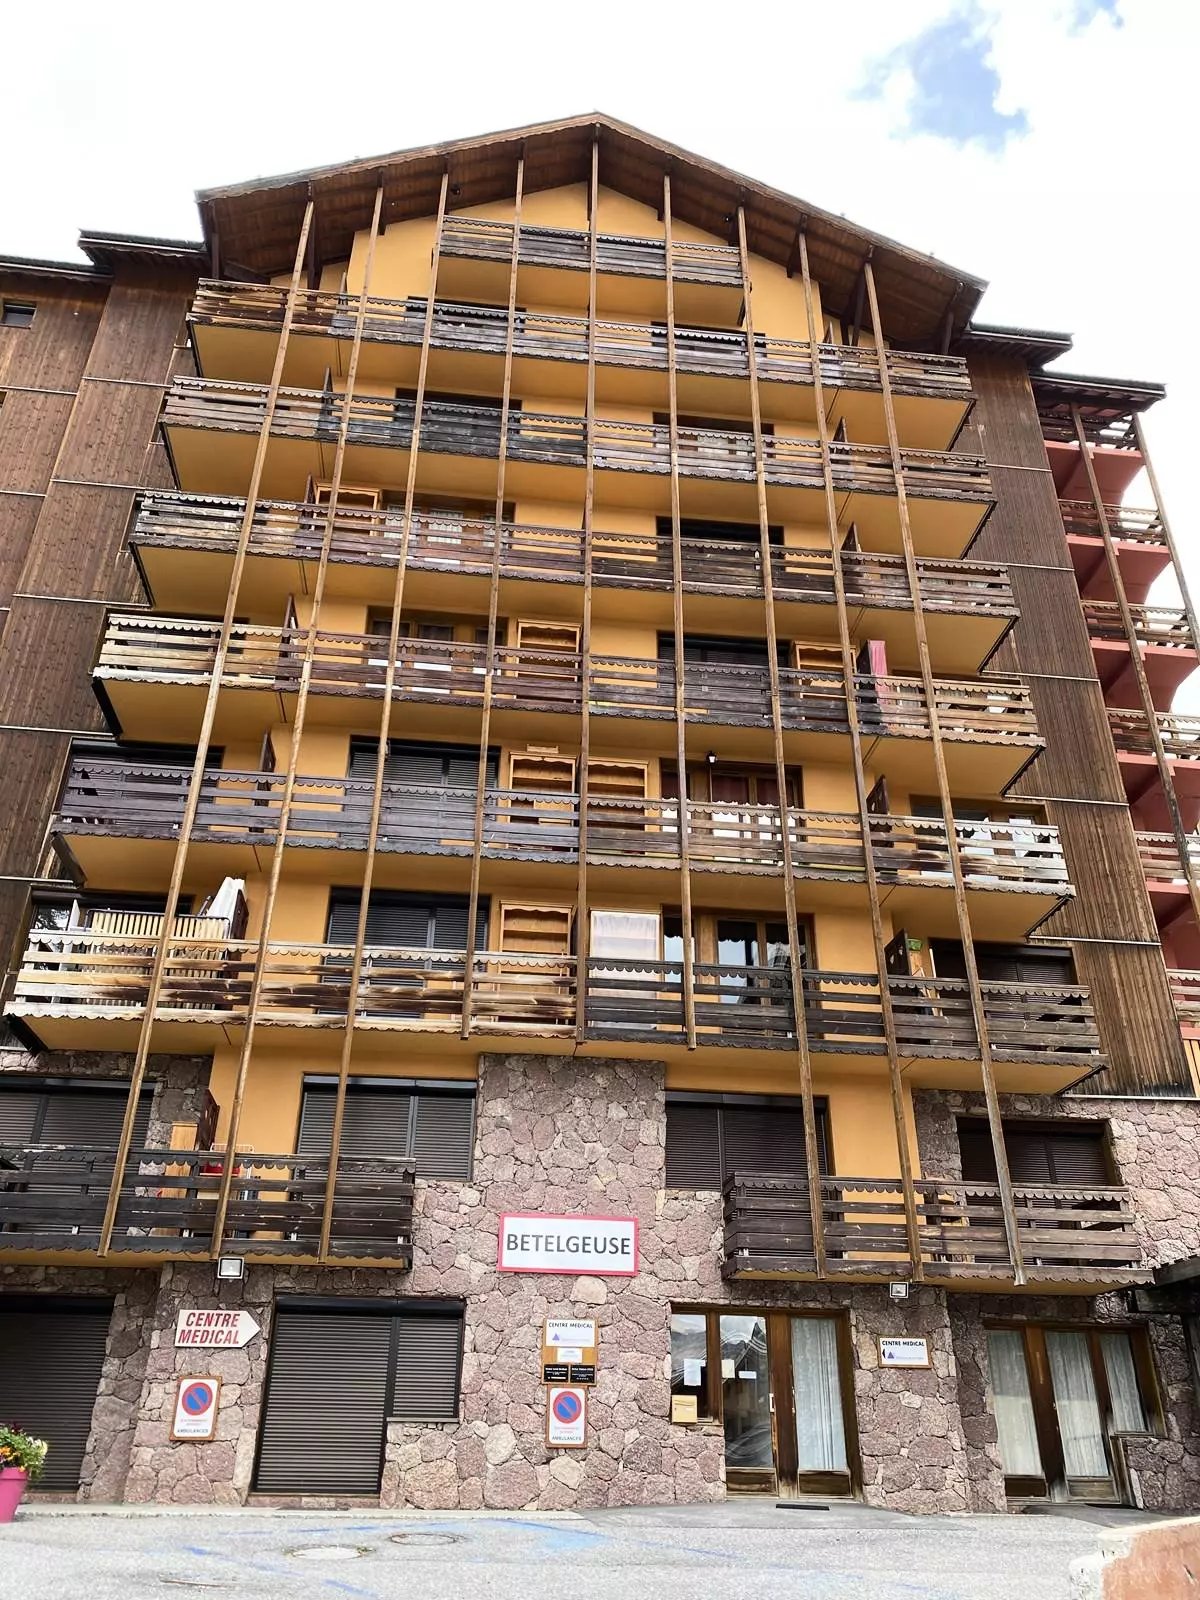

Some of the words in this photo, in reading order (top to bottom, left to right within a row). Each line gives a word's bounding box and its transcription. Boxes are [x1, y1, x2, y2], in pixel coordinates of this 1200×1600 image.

[507, 1234, 630, 1255] BETELGEUSE
[185, 1312, 240, 1327] CENTRE
[178, 1329, 239, 1344] MEDICAL
